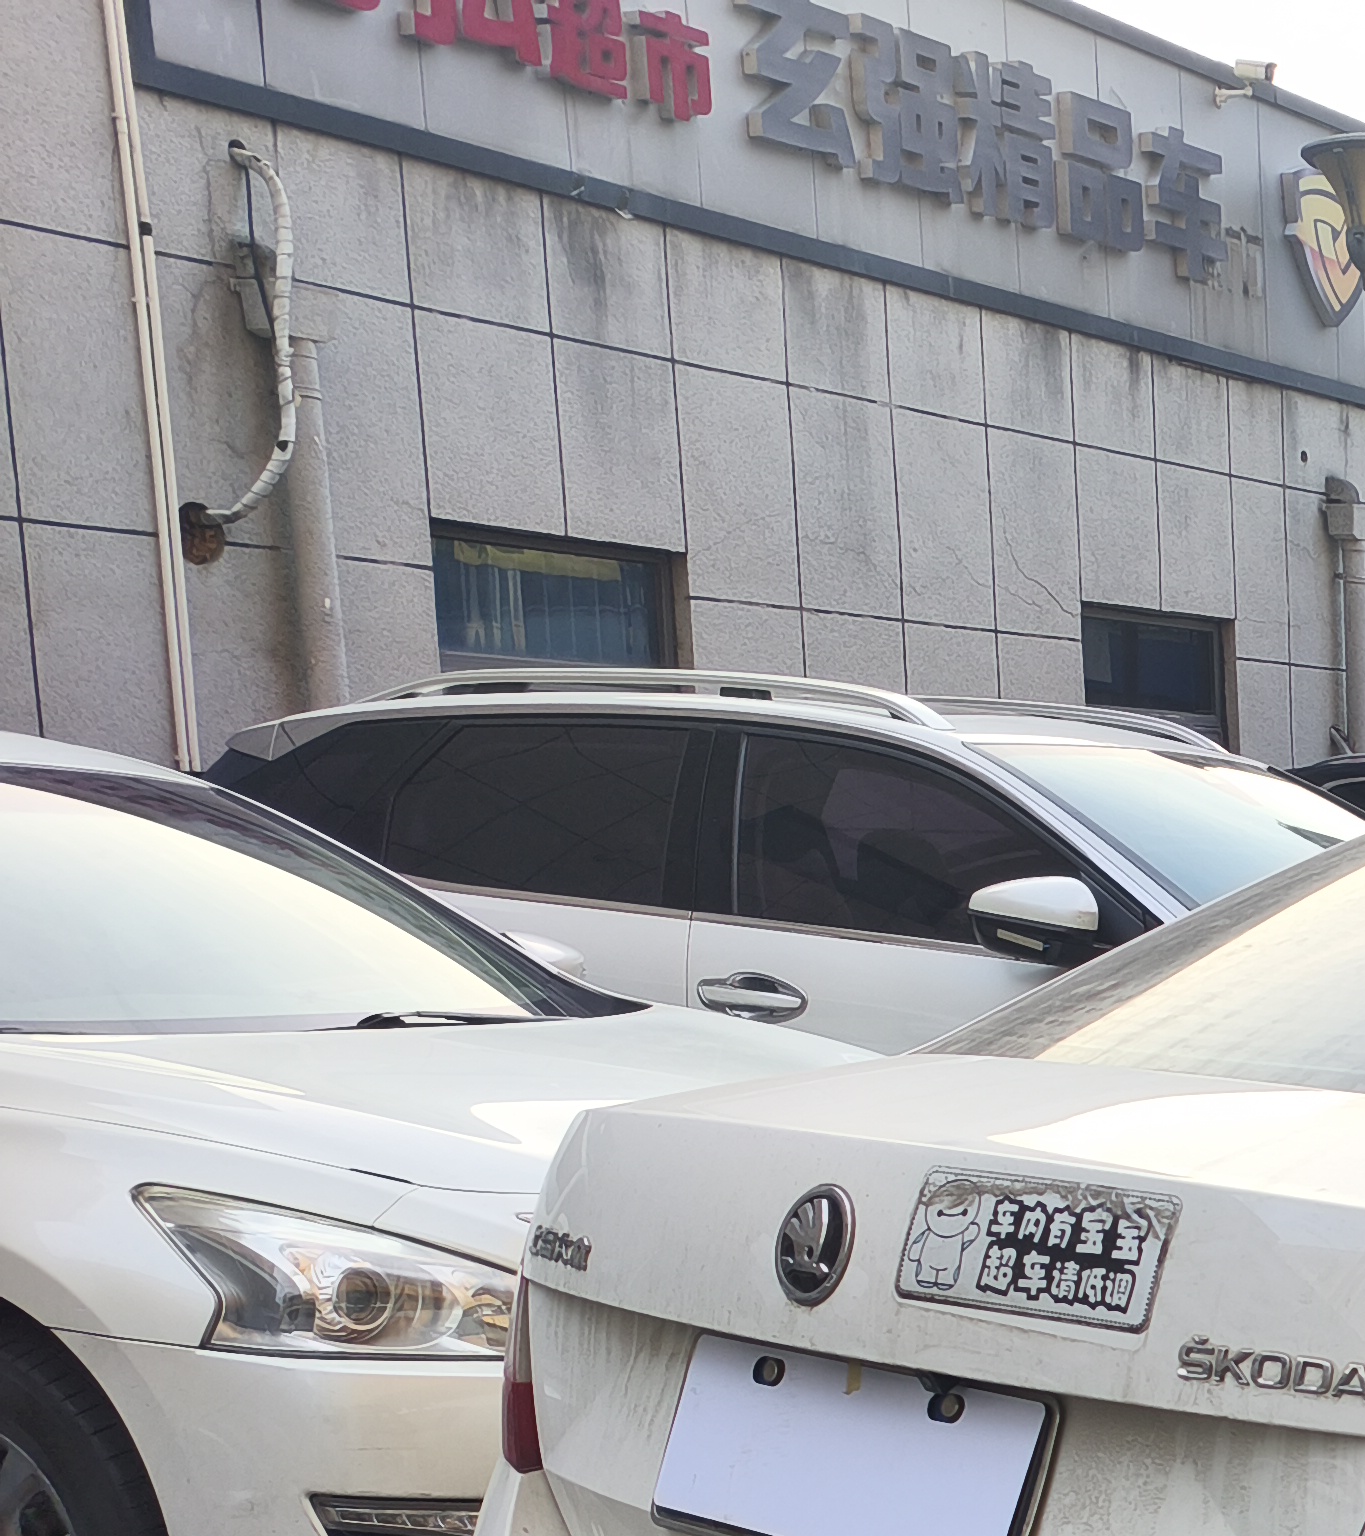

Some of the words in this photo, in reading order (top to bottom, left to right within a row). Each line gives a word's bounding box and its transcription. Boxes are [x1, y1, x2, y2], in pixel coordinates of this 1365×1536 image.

[990, 1201, 1149, 1262] 车内有宝宝
[982, 1245, 1134, 1308] 超车请低调
